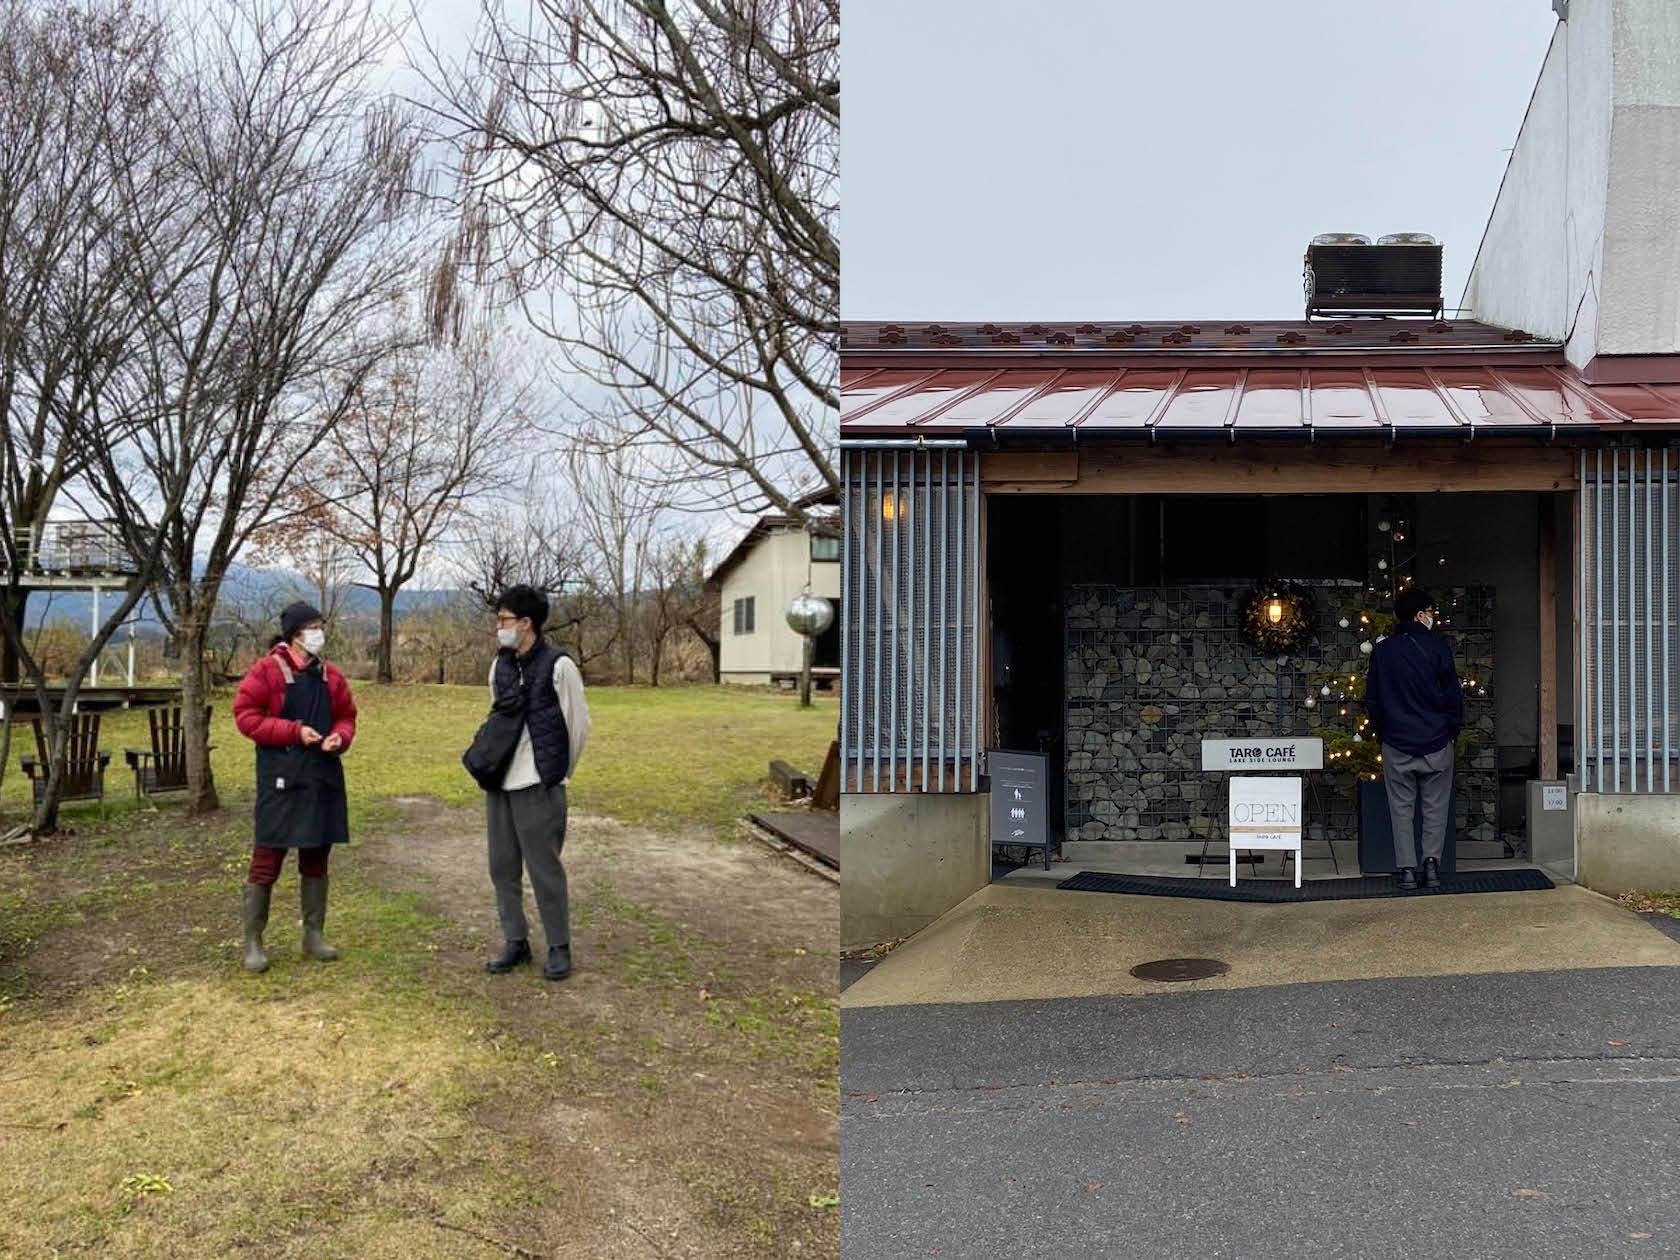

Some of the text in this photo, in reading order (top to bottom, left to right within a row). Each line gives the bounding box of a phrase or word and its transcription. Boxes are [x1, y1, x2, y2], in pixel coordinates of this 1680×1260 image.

[1229, 744, 1296, 758] TARO CAFÉ
[1233, 802, 1297, 823] OPEN
